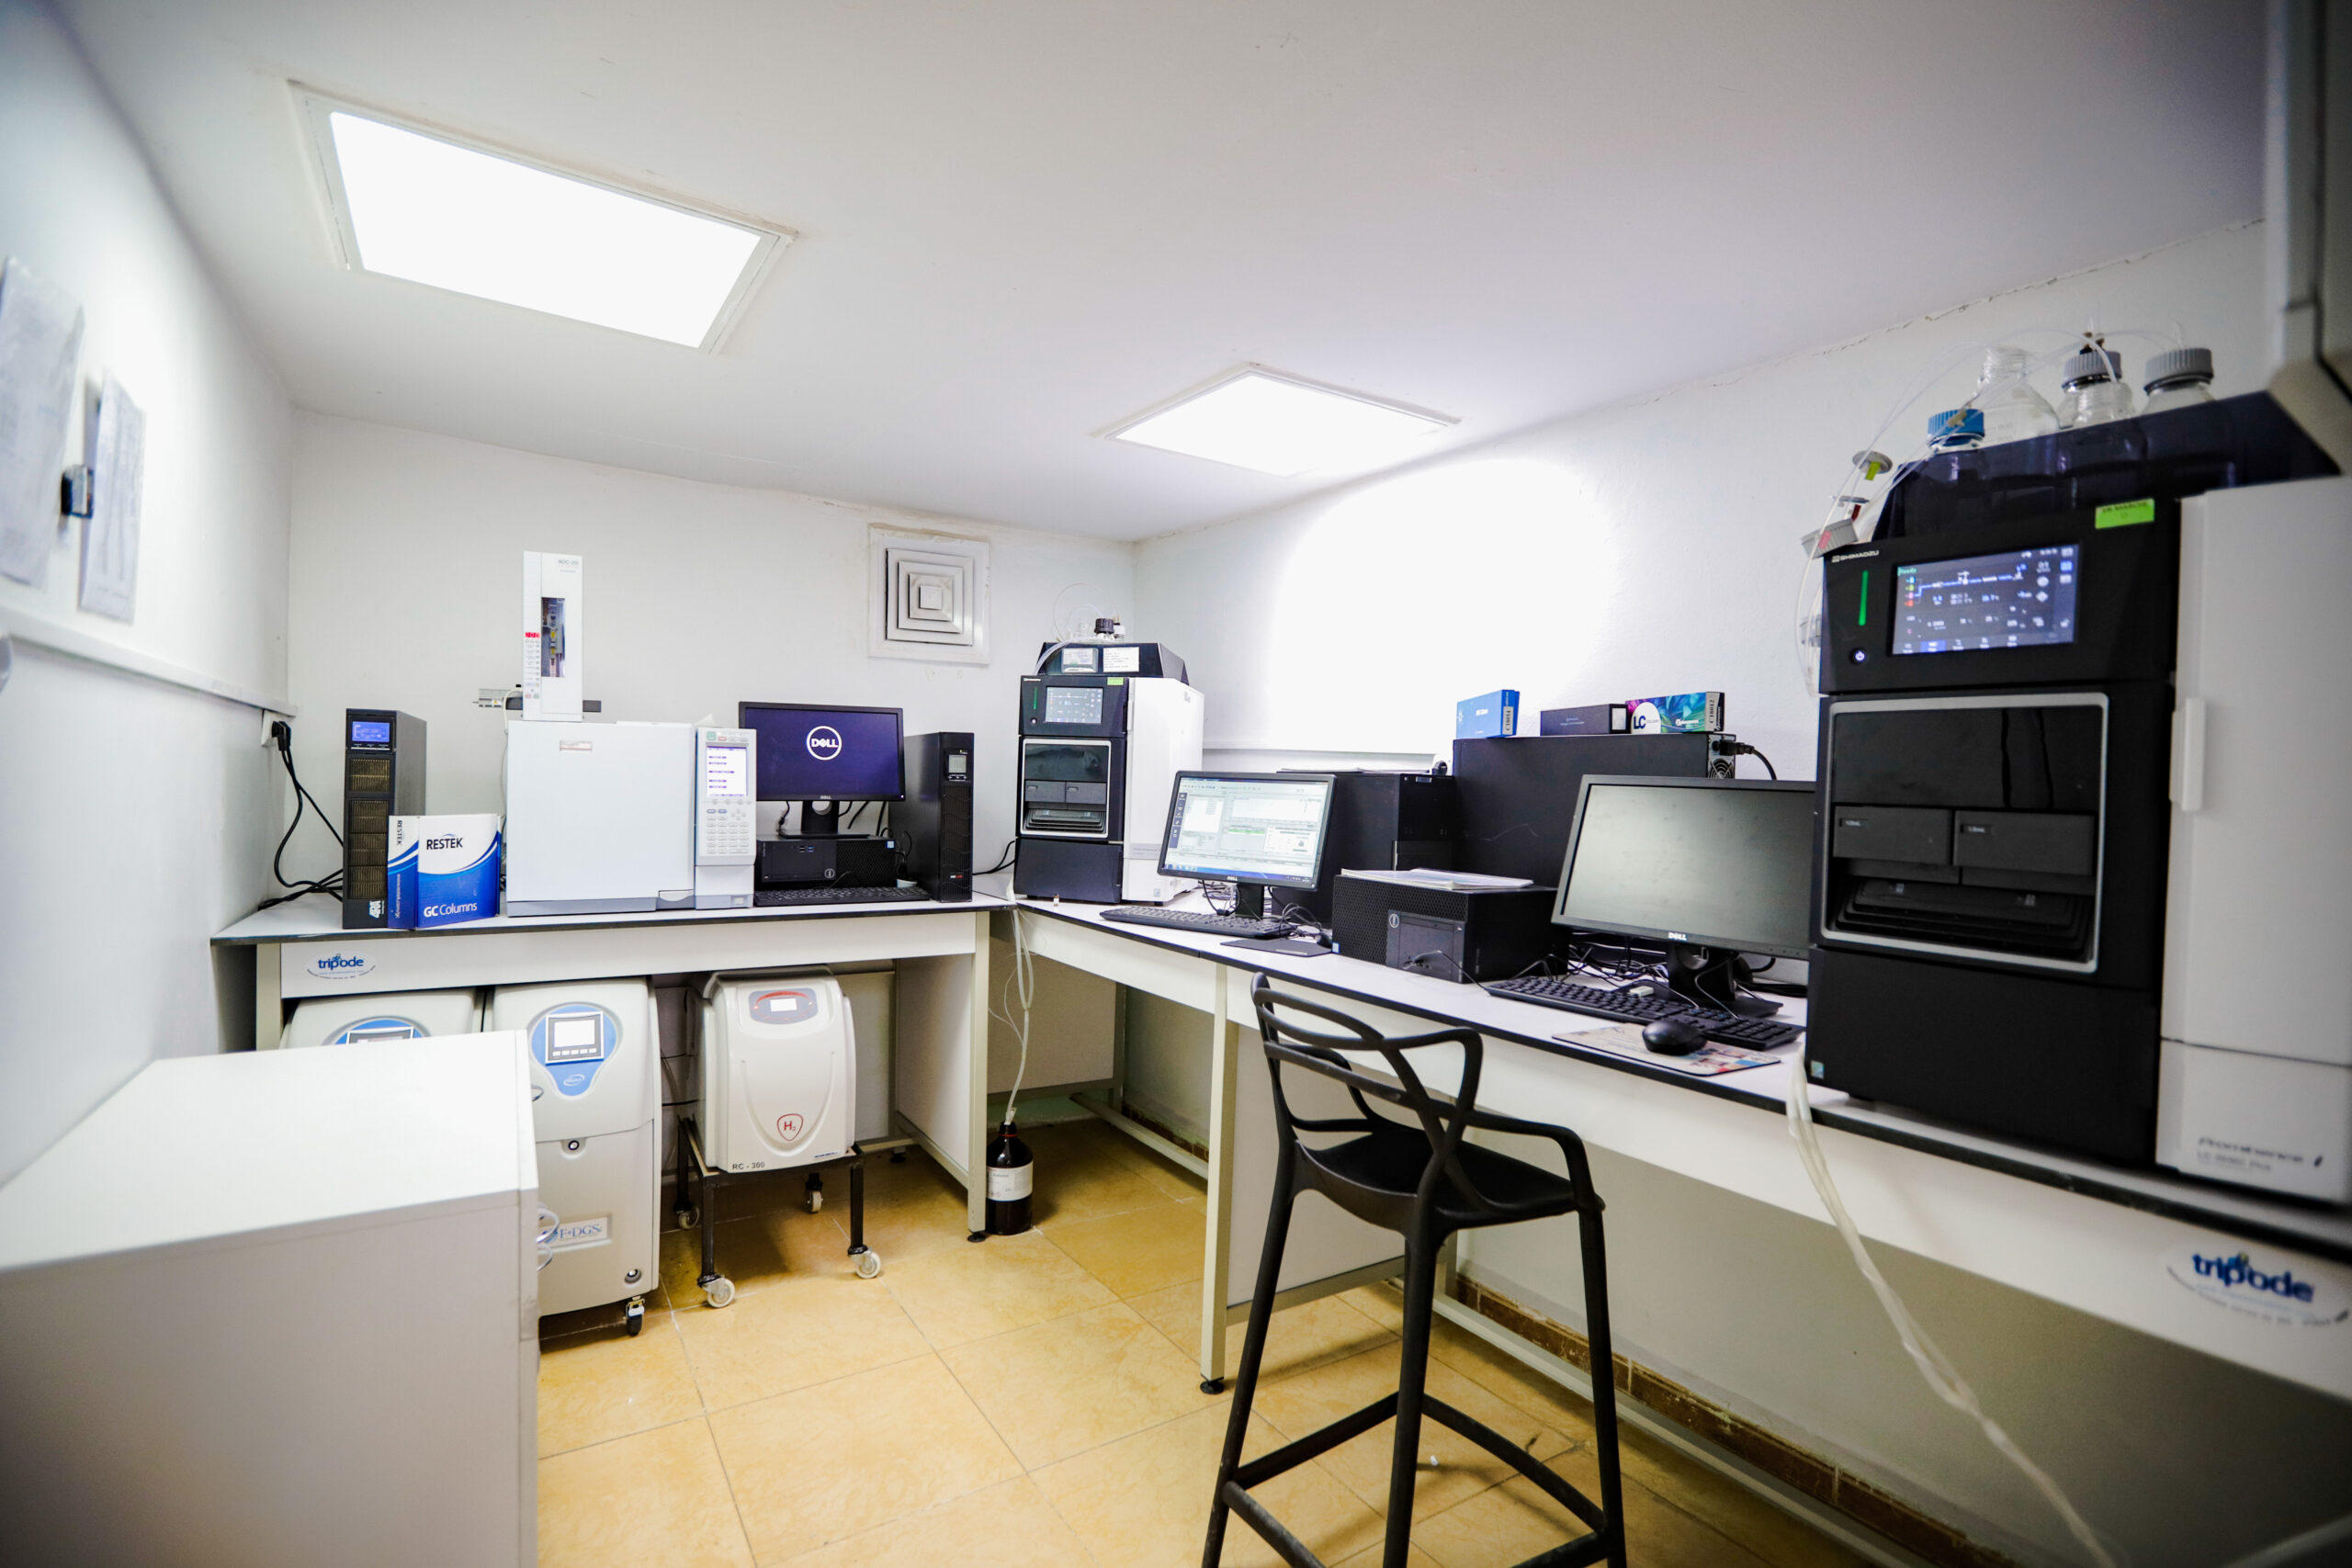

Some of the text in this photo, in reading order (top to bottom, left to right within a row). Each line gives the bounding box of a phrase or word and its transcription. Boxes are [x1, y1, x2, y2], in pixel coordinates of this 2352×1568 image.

[1633, 715, 1646, 729] LC
[810, 738, 839, 749] DELL
[426, 838, 464, 851] RESTEK
[424, 902, 478, 918] GC Columns
[1668, 931, 1687, 941] DELL
[318, 956, 364, 971] tripode
[751, 1161, 765, 1169] 300
[2192, 1254, 2315, 1303] tripode
